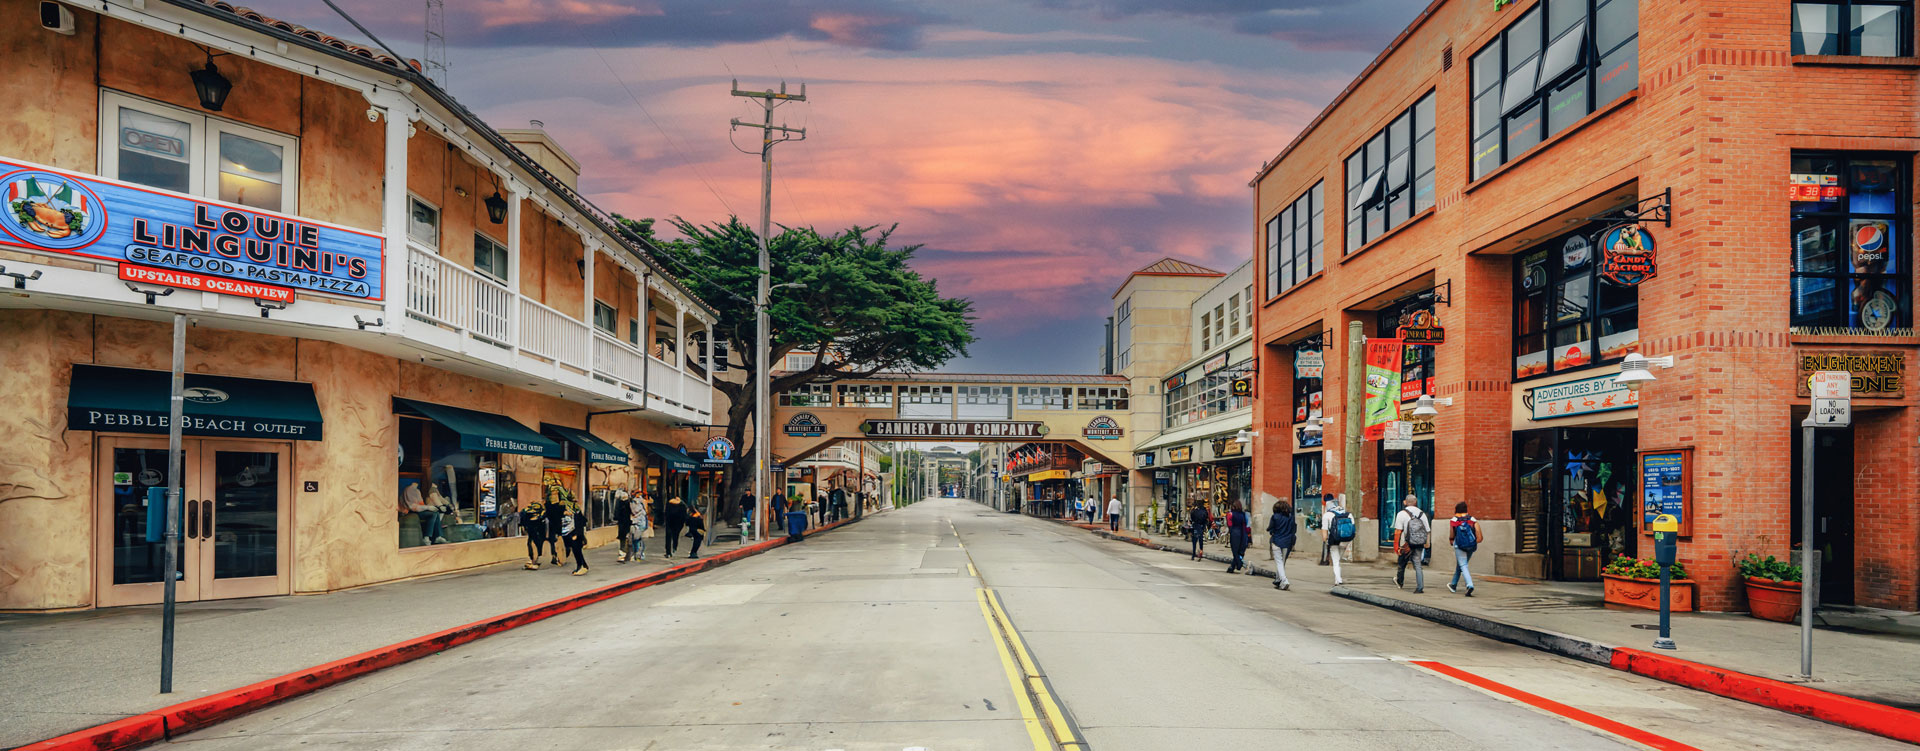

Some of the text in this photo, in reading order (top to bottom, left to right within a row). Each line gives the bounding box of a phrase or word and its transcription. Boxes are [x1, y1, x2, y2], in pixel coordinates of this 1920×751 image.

[126, 131, 182, 155] OPEN
[1805, 186, 1818, 196] 38
[195, 203, 319, 249] LOUIE
[133, 217, 367, 279] LINGUINI'S
[1613, 254, 1647, 263] CANDY
[1857, 252, 1883, 261] pepsi
[131, 247, 366, 295] SEAFOOD PASTA PIZZA
[1608, 263, 1651, 272] FACTORY
[125, 267, 289, 299] UPSTAIRS OCEANVIEW
[1401, 329, 1425, 340] GENERAL
[1804, 353, 1904, 373] ENLIGHTENMENT
[1537, 383, 1590, 400] ADVENTURES
[1593, 379, 1606, 390] BY
[1850, 375, 1901, 393] ONE
[1820, 407, 1845, 415] LOADING
[1828, 400, 1836, 408] NO
[88, 411, 306, 434] PEBBLE BEACH OUTLET
[792, 414, 810, 424] CANNERY
[876, 422, 1034, 436] CANNERY ROW COMPANY
[485, 438, 543, 453] PEBBLE BEACH OUTLET
[605, 453, 617, 461] BEACH
